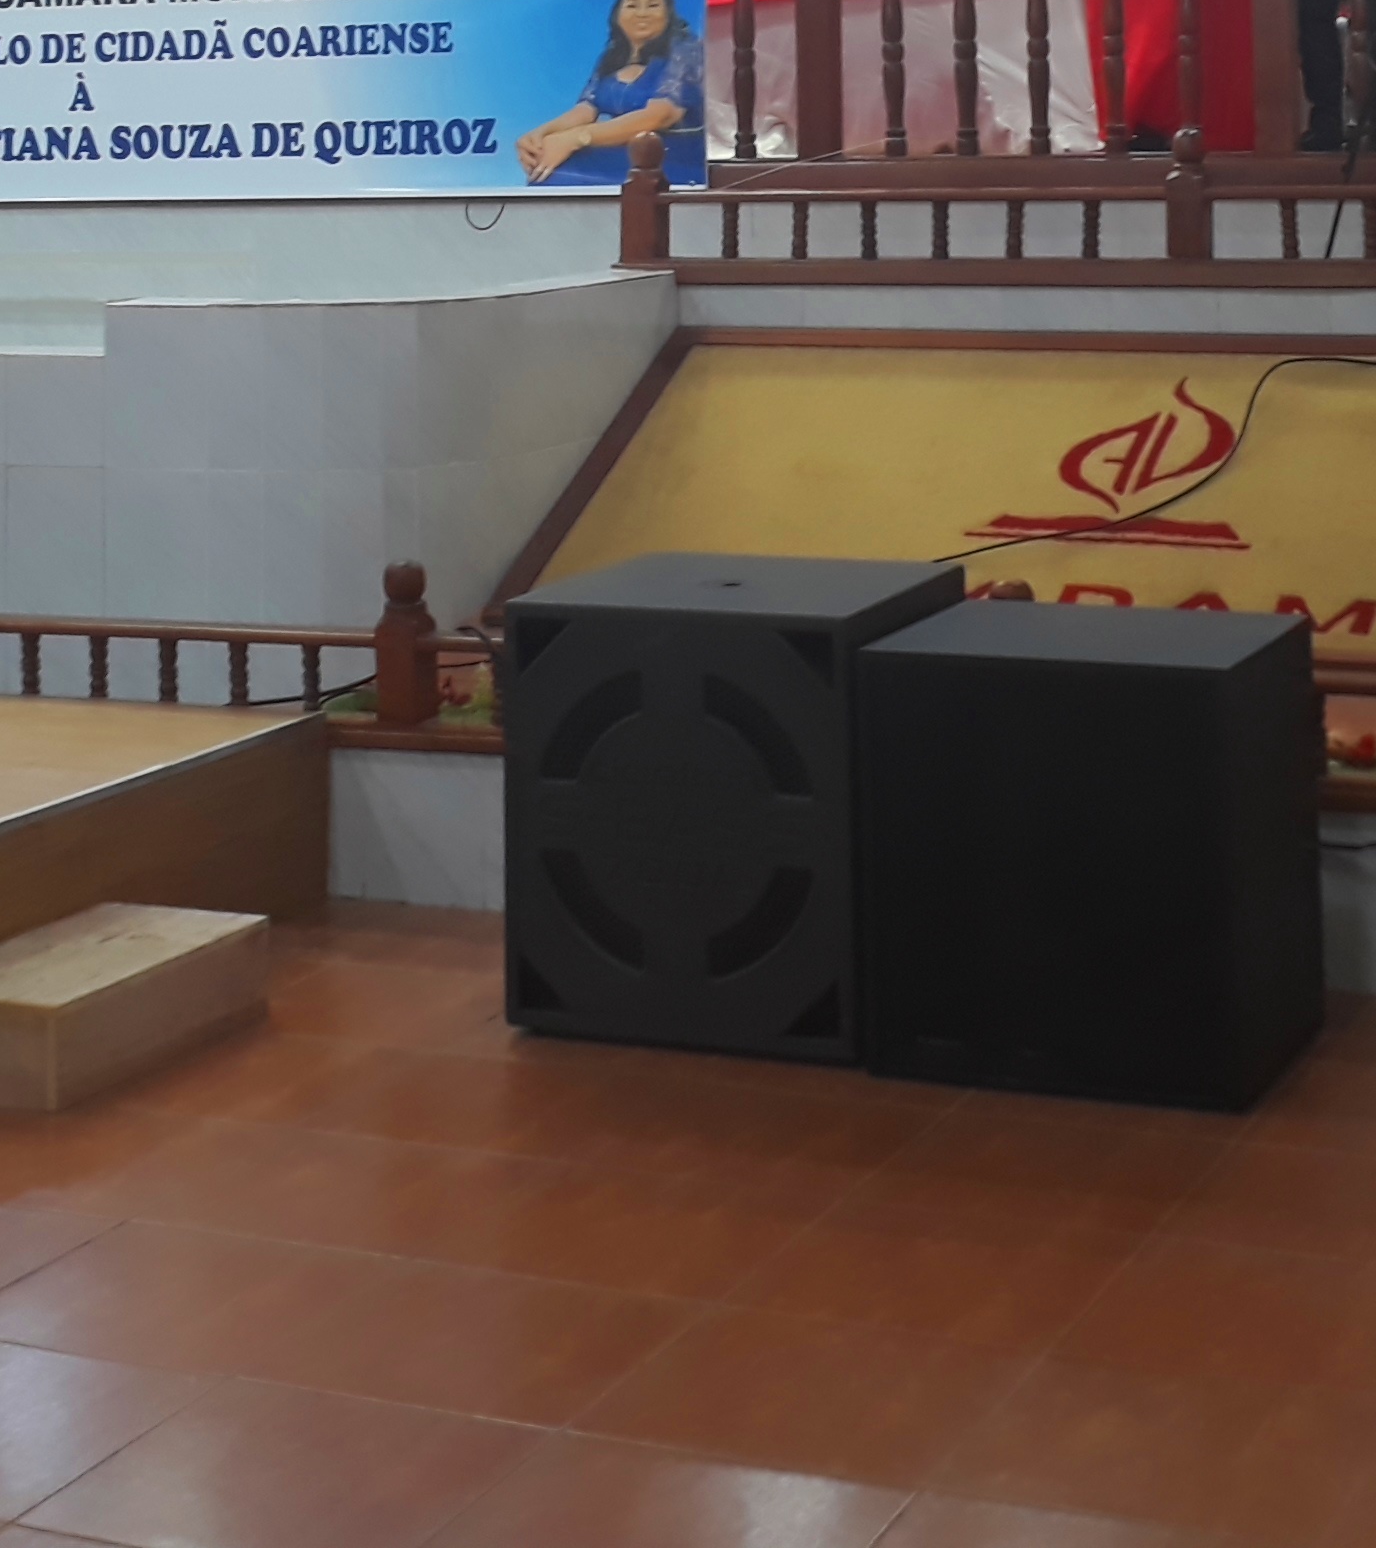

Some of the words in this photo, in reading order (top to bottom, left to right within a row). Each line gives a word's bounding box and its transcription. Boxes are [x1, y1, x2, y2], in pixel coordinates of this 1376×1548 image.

[40, 31, 86, 64] DE
[94, 19, 233, 63] CIDADÃ
[242, 21, 454, 59] COARIENSE
[68, 72, 96, 112] À
[109, 122, 242, 161] SOUZA
[251, 121, 305, 157] DE
[313, 118, 498, 167] QUEIROZ
